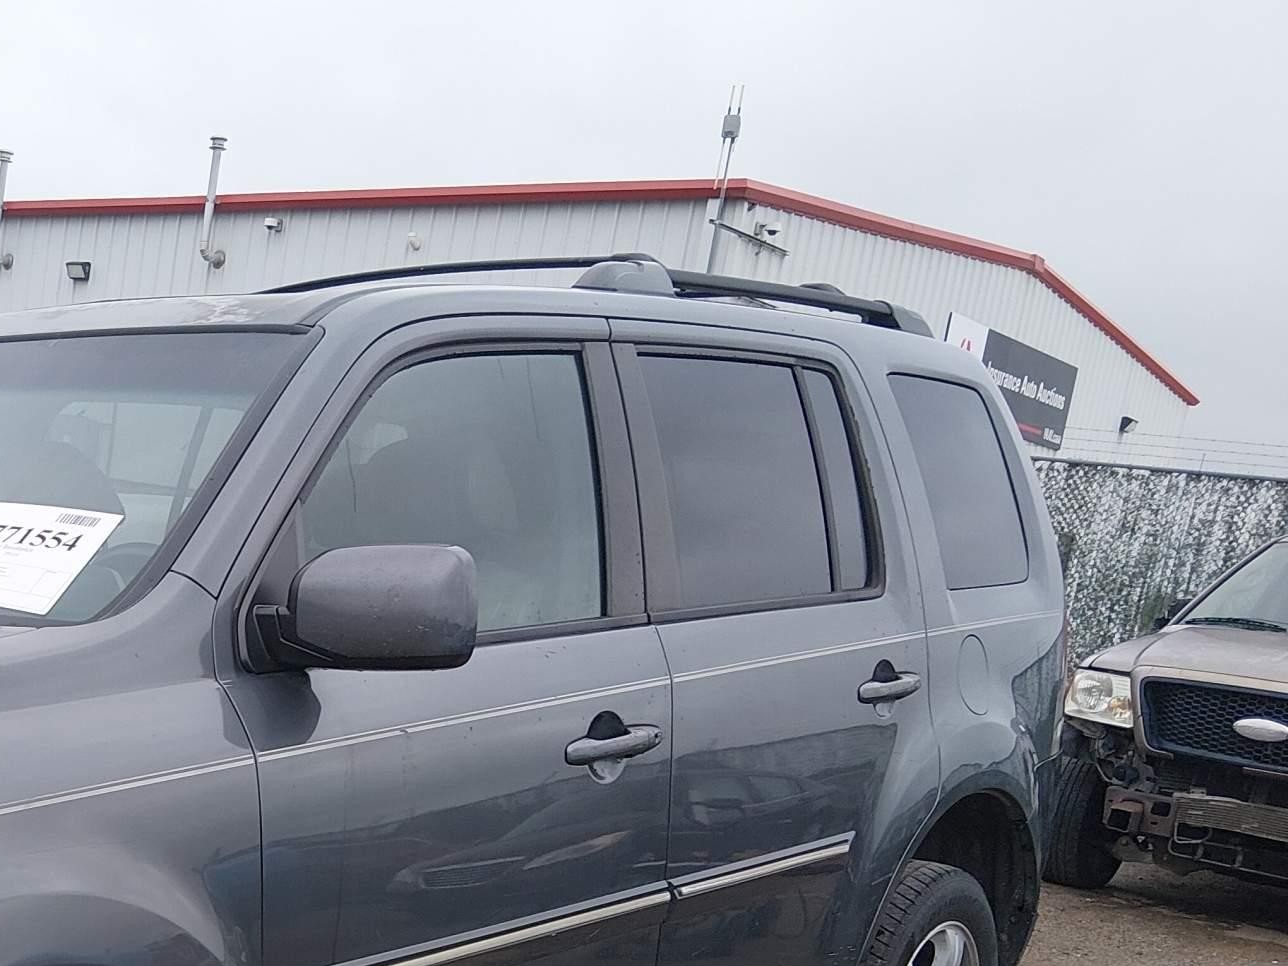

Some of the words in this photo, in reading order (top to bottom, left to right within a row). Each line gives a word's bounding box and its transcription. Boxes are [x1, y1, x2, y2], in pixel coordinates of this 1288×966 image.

[988, 361, 1021, 393] Insurance
[1020, 375, 1037, 399] Auto
[1036, 382, 1065, 410] Auctions
